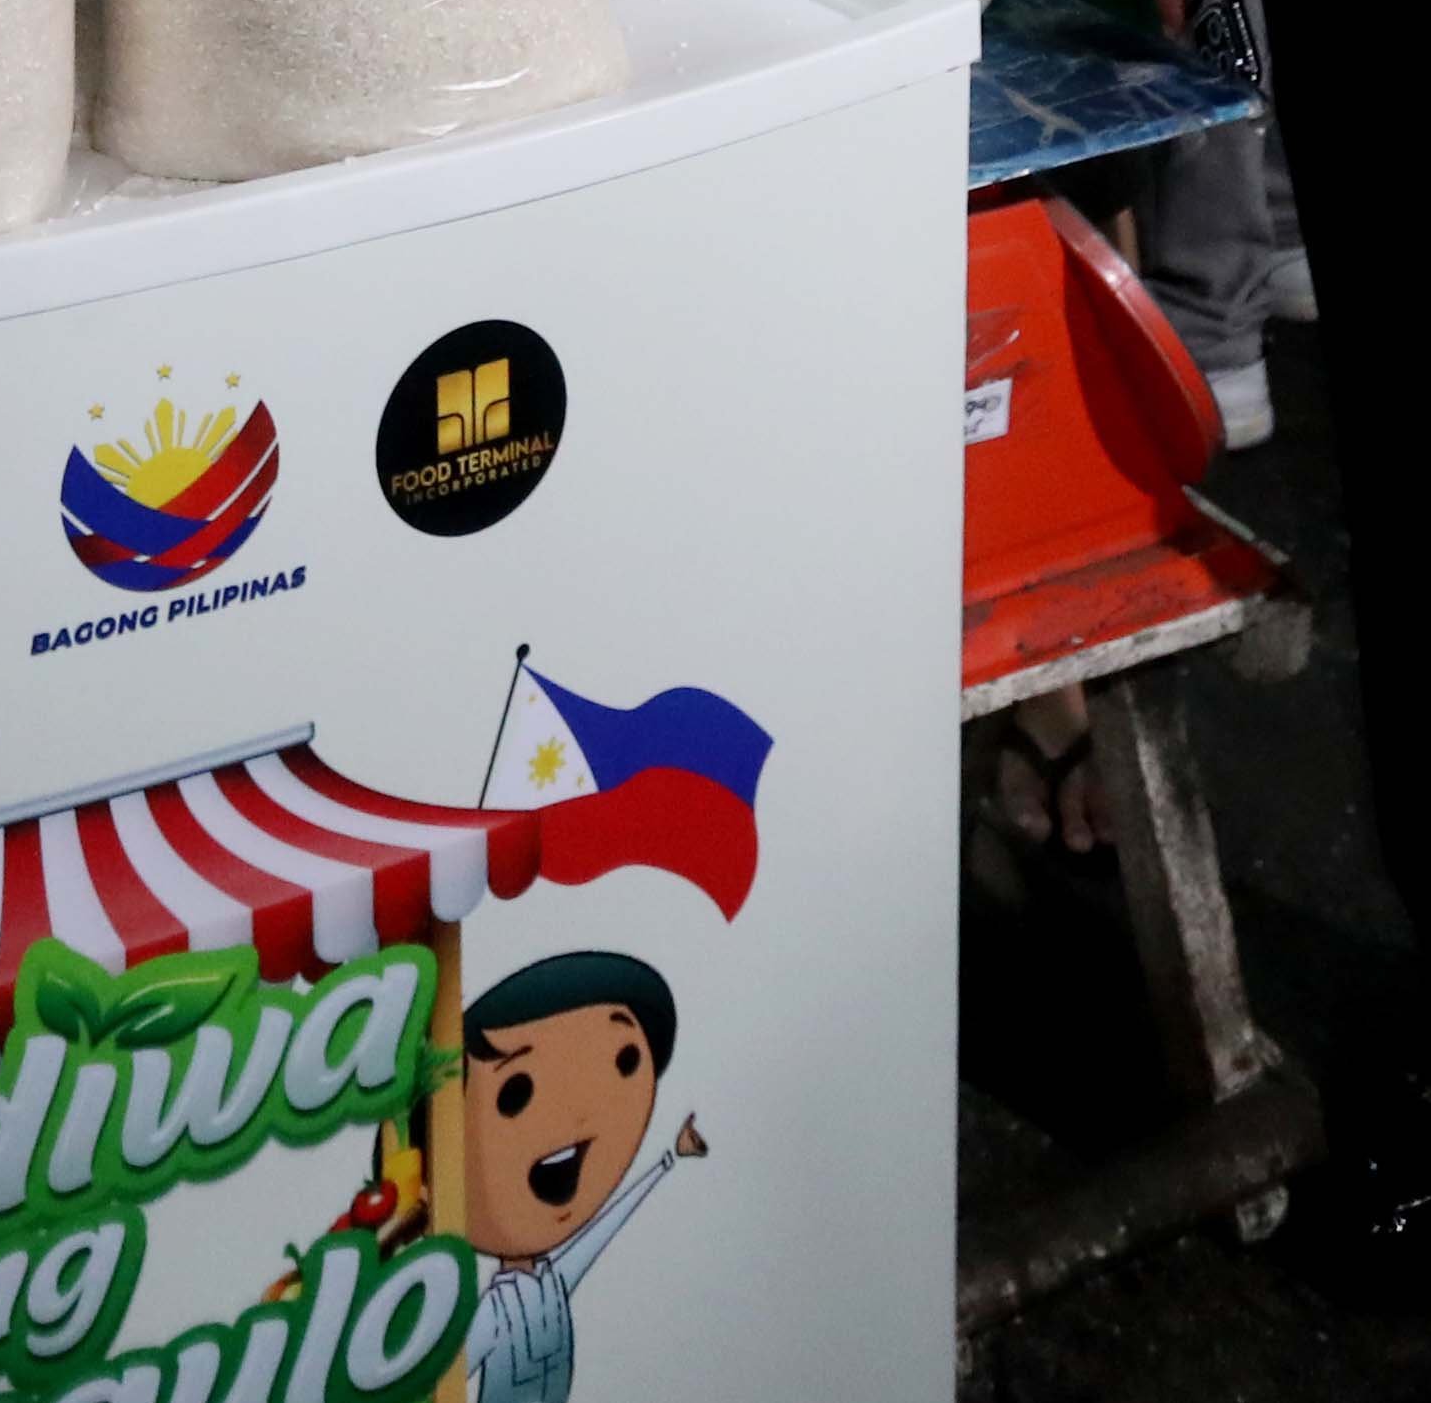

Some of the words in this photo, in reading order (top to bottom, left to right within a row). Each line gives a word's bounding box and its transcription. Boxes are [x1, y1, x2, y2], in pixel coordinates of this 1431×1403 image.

[391, 461, 451, 496] FOOD
[457, 430, 555, 476] TERMINAL
[405, 456, 542, 506] INCORPORATED
[30, 603, 160, 656] BAGONG
[166, 564, 307, 626] PILIPINAS
